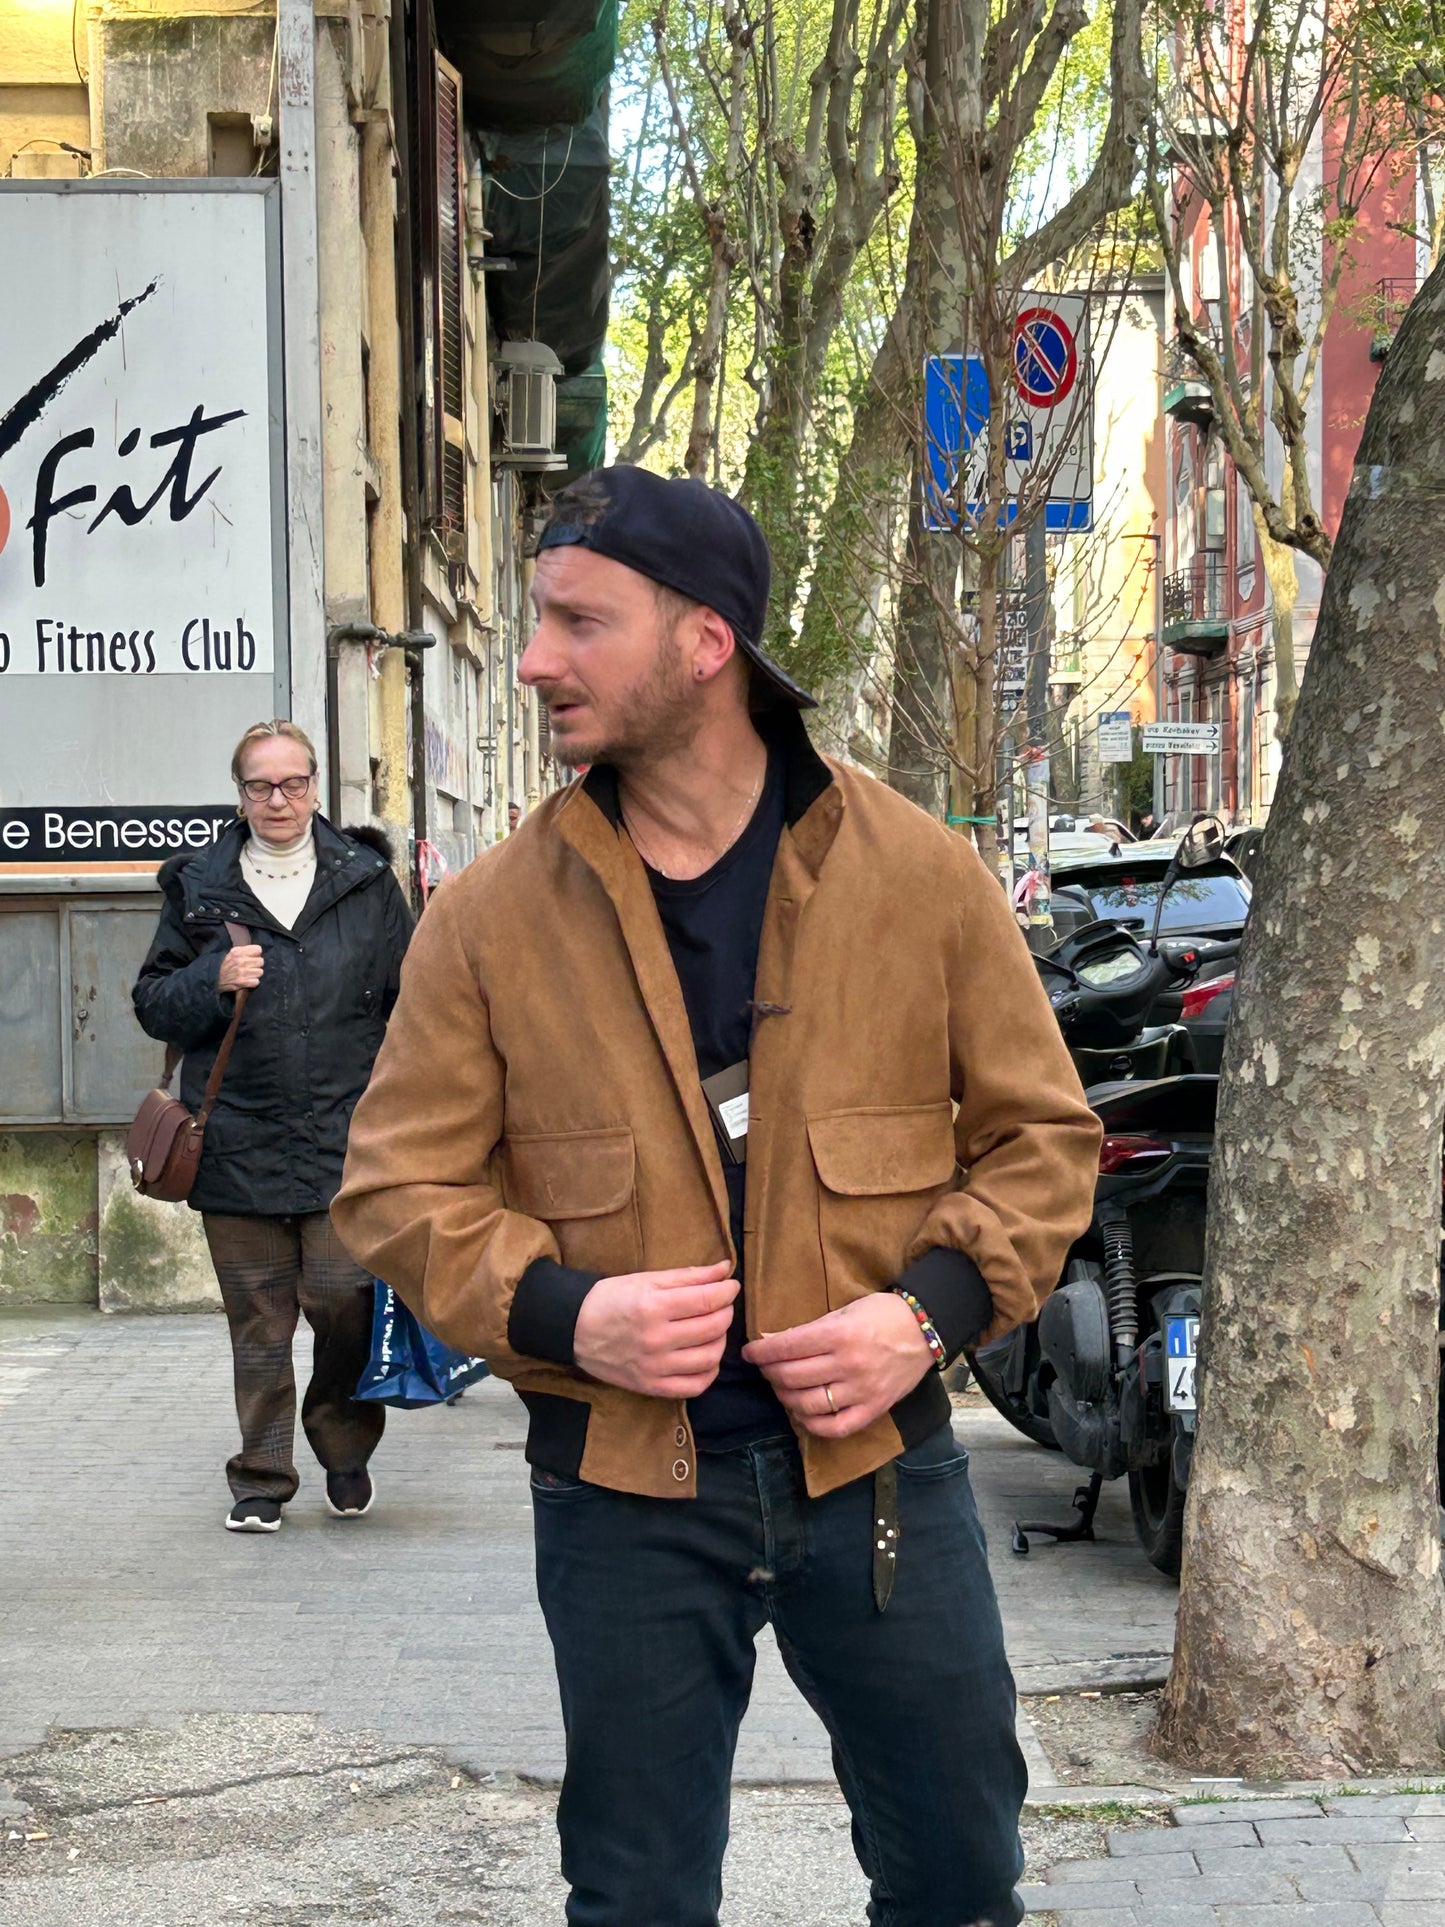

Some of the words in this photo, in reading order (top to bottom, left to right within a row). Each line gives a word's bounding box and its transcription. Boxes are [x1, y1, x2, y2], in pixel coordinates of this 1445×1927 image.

[36, 619, 156, 673] Fitness
[182, 617, 256, 671] Club
[2, 820, 31, 850] e
[44, 812, 233, 850] Benesser
